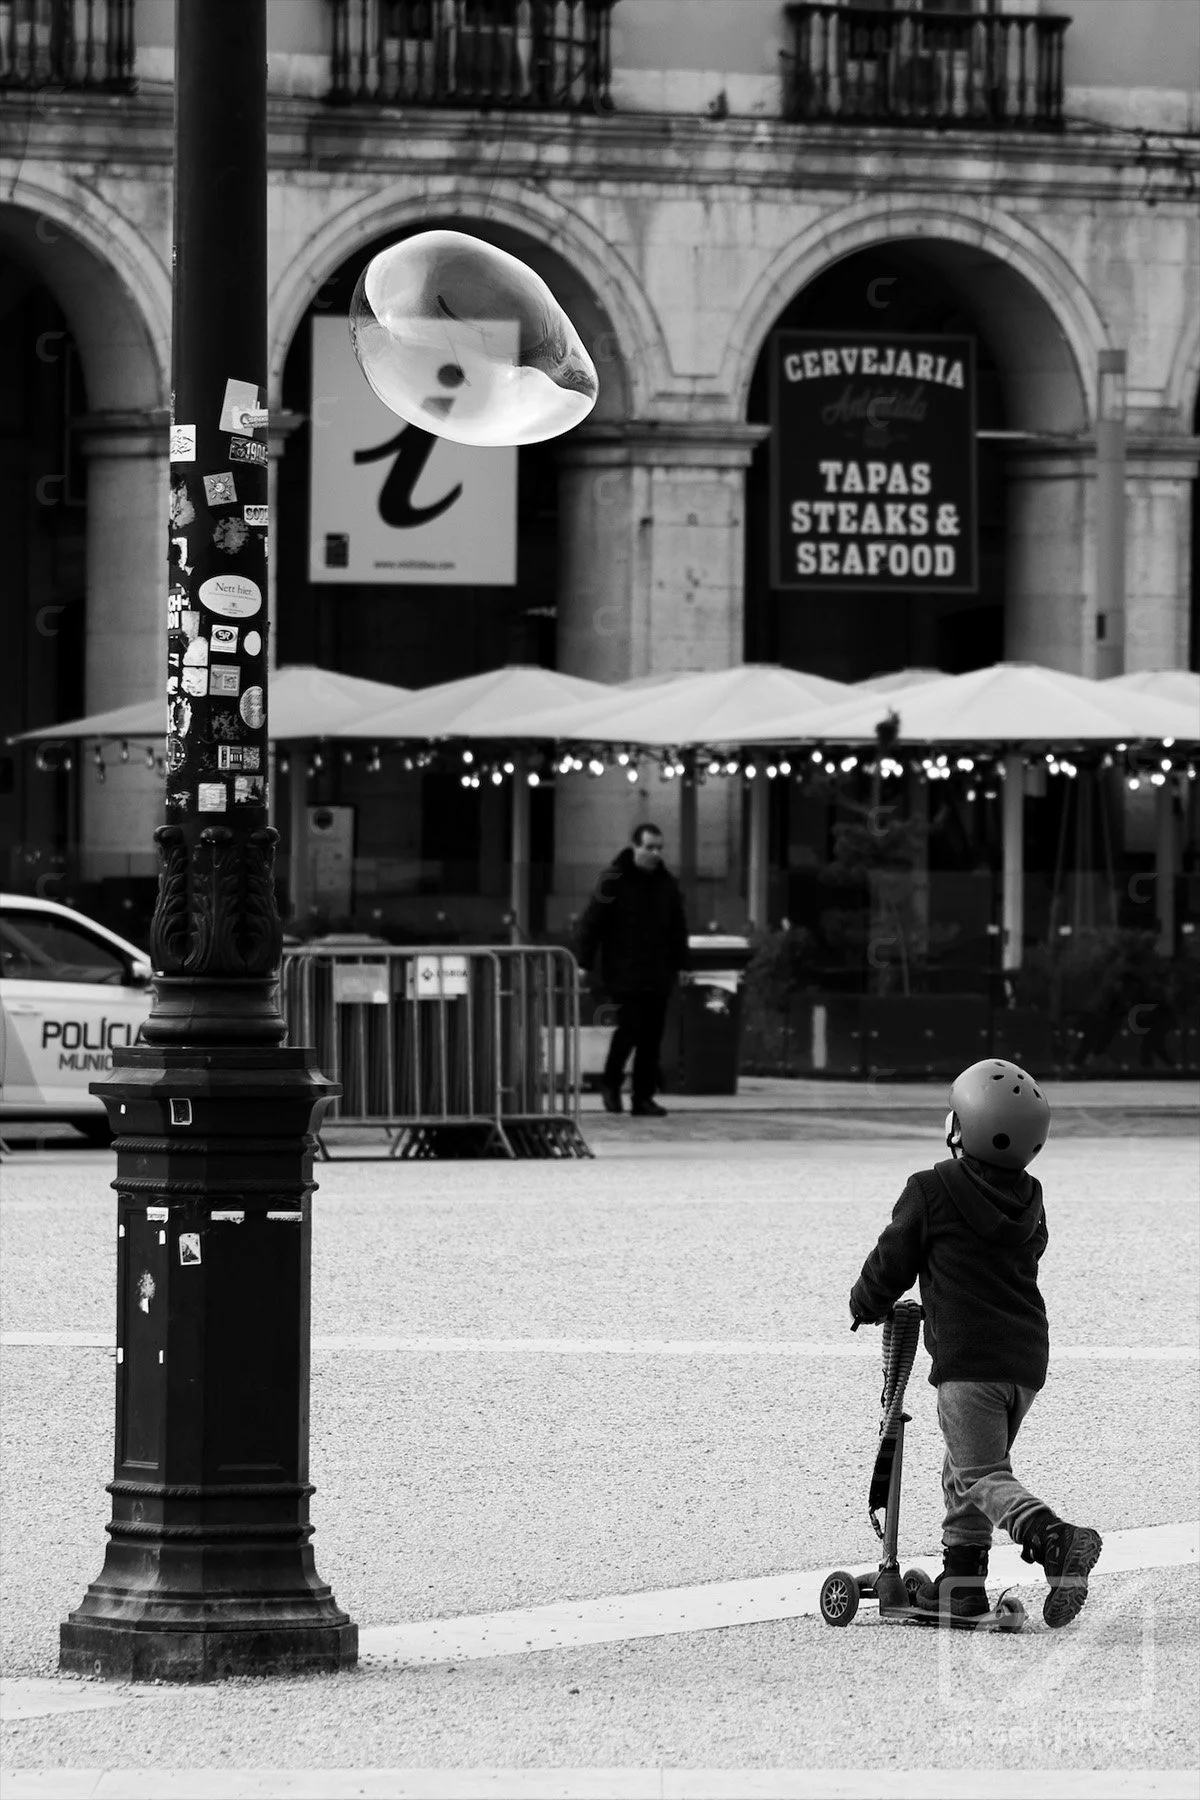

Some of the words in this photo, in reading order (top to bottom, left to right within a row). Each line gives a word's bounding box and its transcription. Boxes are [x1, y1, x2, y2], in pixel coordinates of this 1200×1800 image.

[784, 346, 965, 389] CERVEJARIA
[819, 460, 932, 495] TAPAS
[791, 501, 930, 536] STEAKS
[935, 503, 961, 536] &
[796, 541, 956, 577] SEAFOOD
[215, 582, 235, 592] Nett
